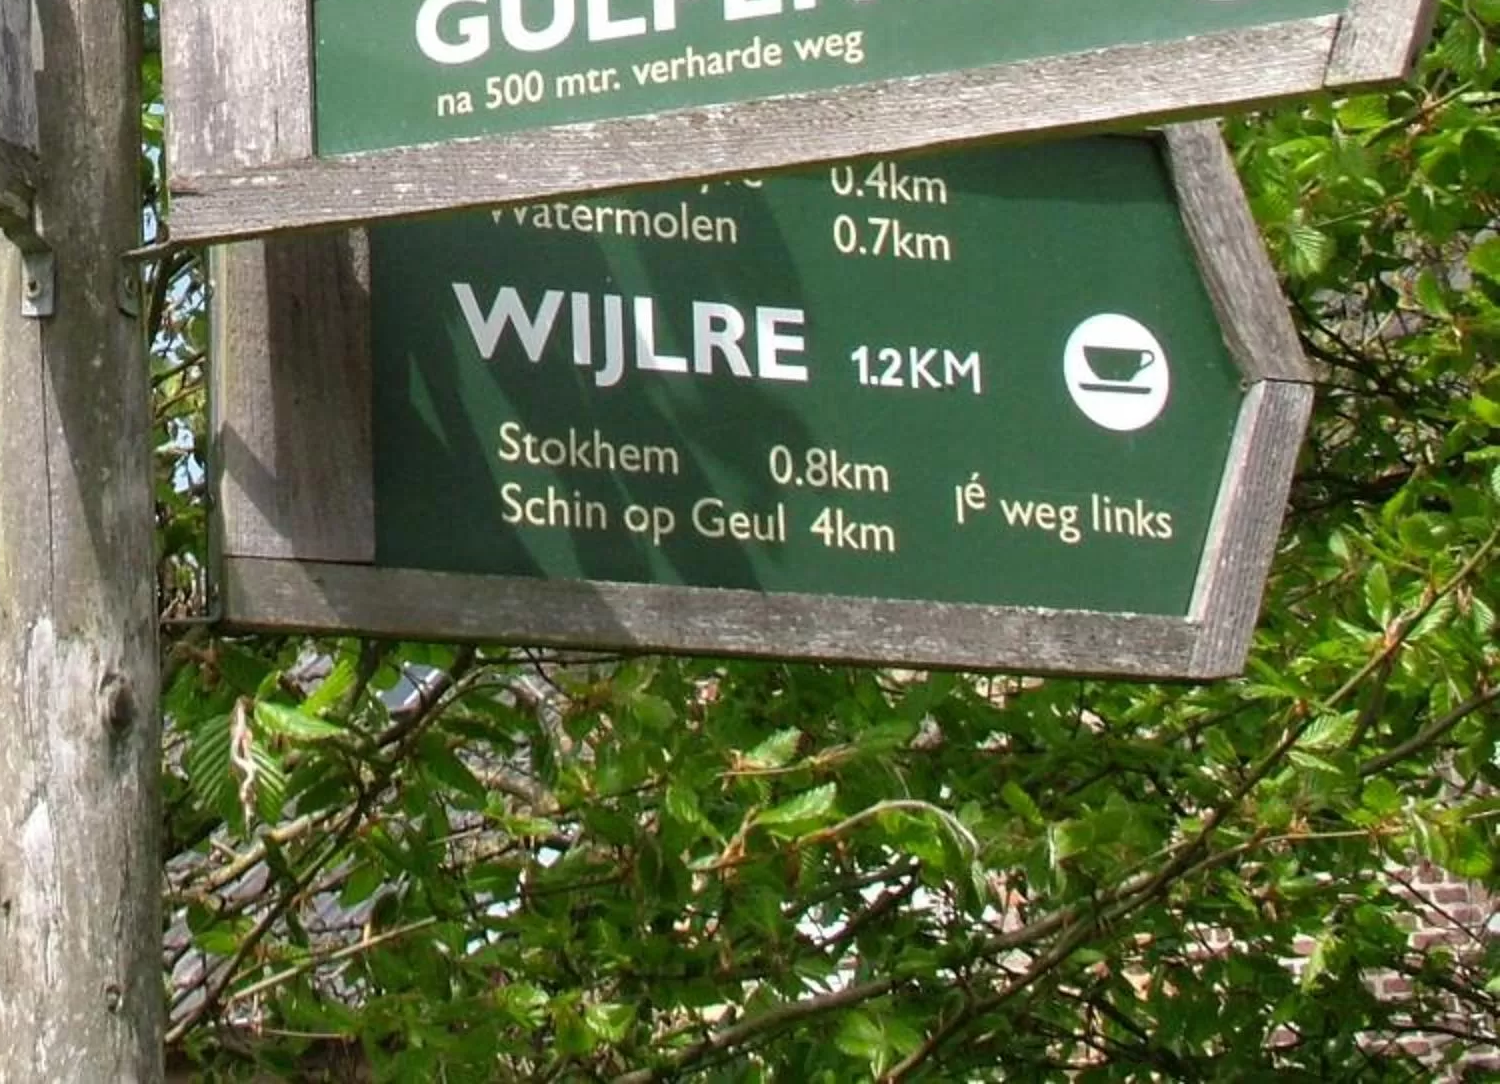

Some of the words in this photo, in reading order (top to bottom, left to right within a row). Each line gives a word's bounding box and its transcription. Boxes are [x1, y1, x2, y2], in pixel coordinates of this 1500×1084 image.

[436, 90, 474, 117] na
[485, 73, 545, 111] 500
[555, 66, 621, 100] mtr.
[630, 37, 784, 85] verharde
[793, 29, 865, 66] weg
[830, 161, 948, 205] 0.4km
[833, 213, 951, 261] 0.7km
[452, 282, 810, 387] WIJLRE
[850, 345, 982, 394] 1.2KM
[497, 421, 680, 476] Stokhem
[768, 444, 891, 493] 0.8km
[499, 482, 608, 530] Schin
[622, 503, 676, 544] op
[691, 497, 787, 544] Geul
[809, 505, 897, 553] 4km
[999, 498, 1082, 545] weg
[1090, 492, 1174, 540] links
